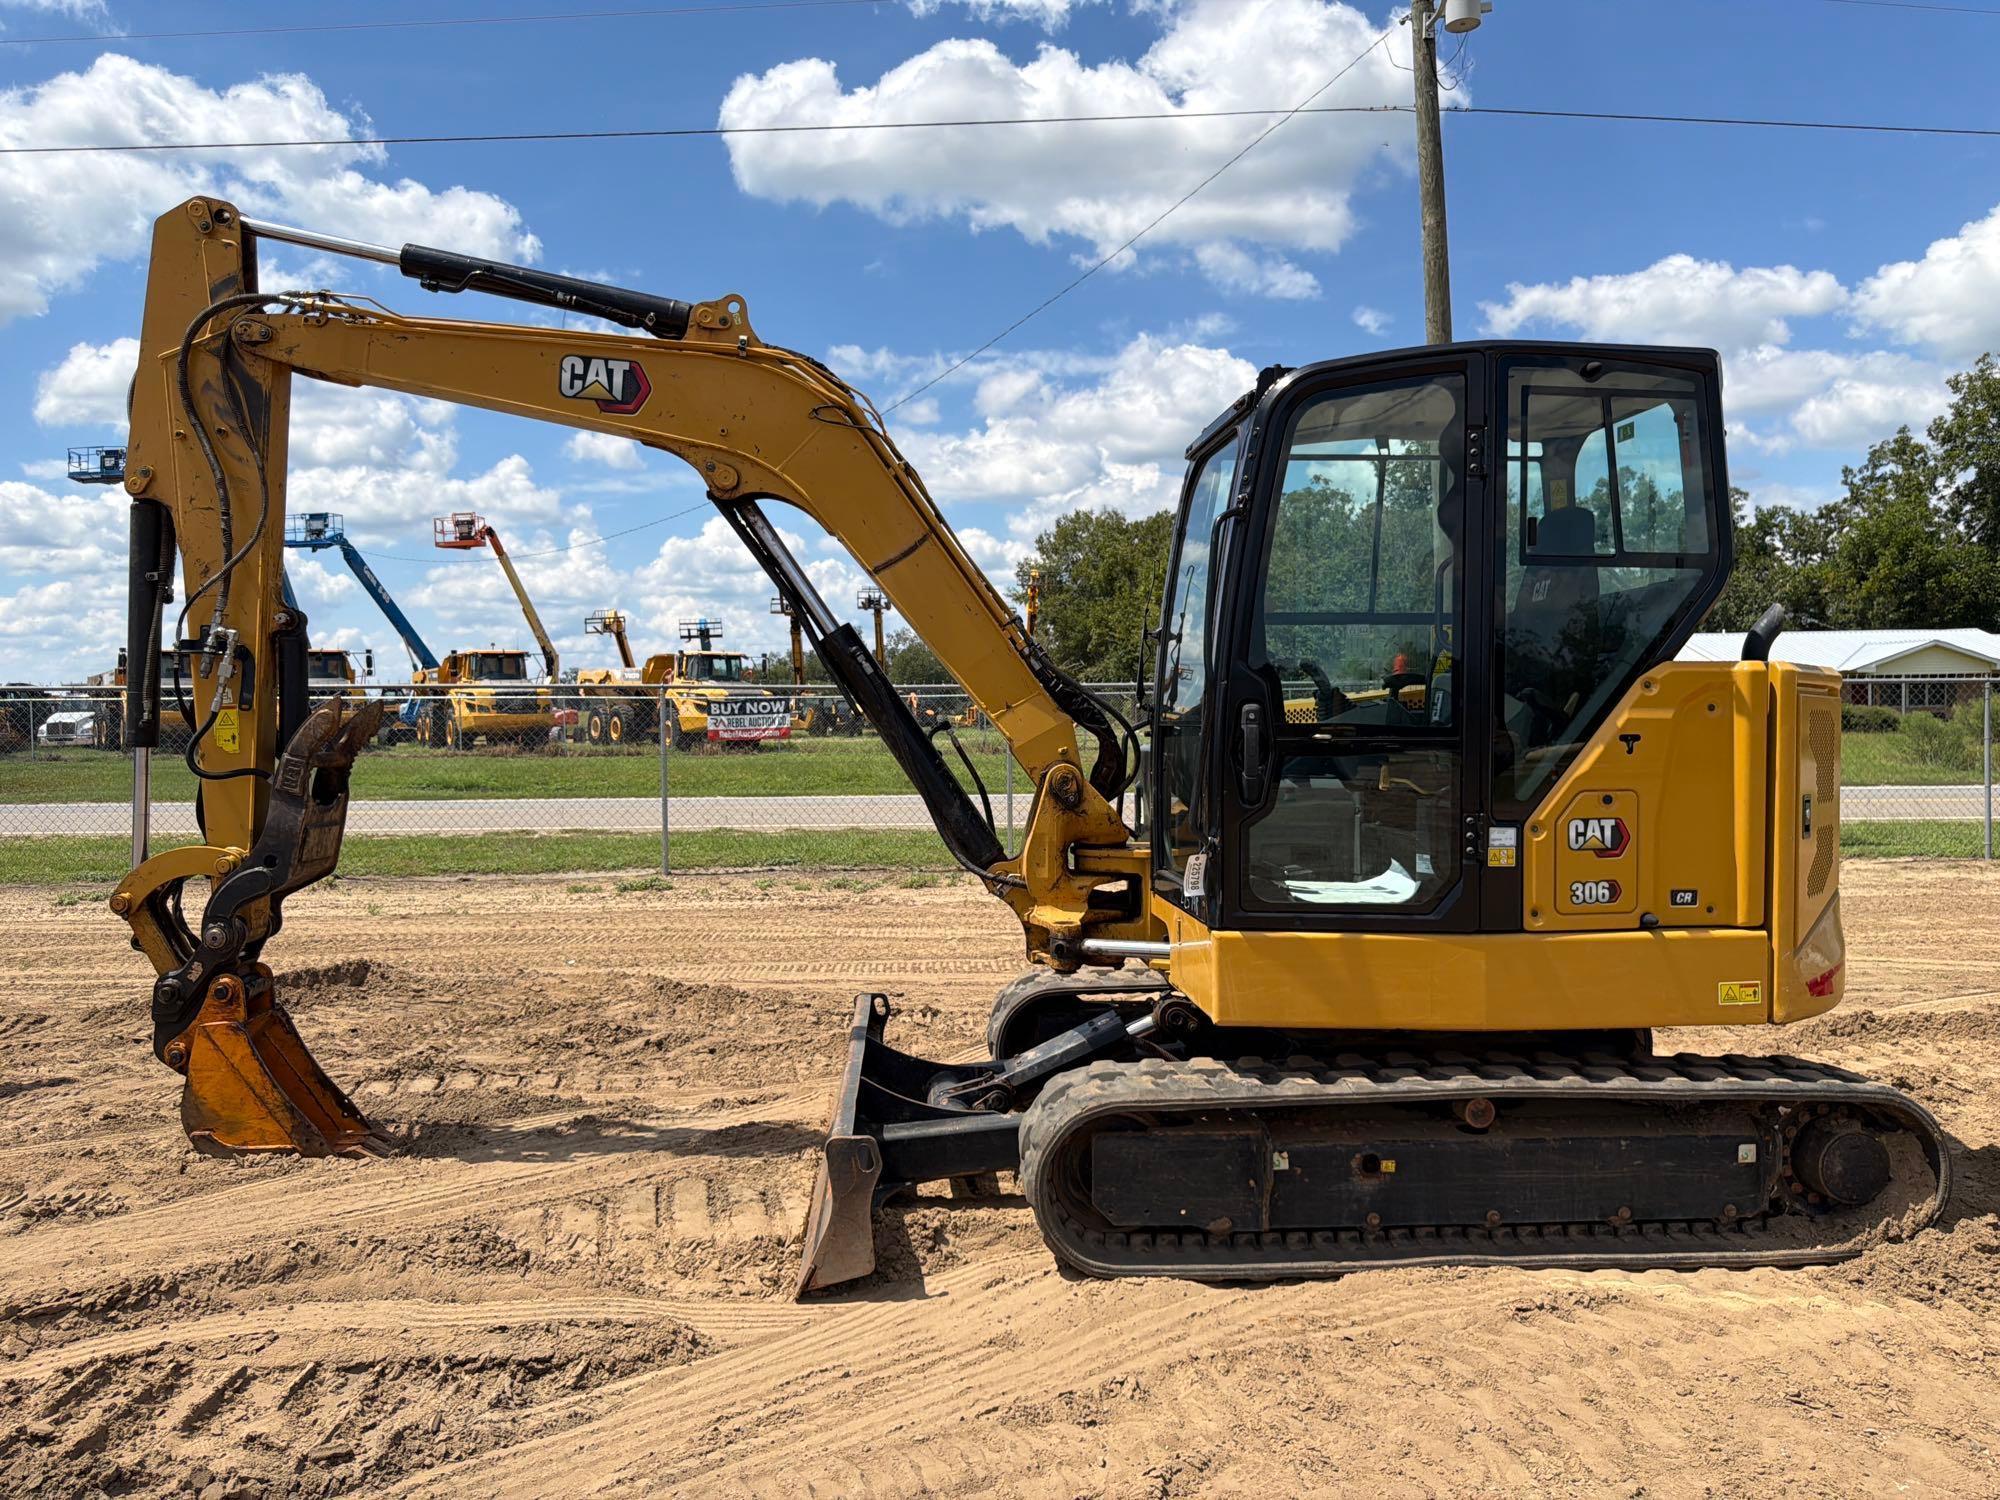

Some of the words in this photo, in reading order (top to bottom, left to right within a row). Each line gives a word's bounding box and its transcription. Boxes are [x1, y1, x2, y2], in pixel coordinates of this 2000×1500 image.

[561, 355, 630, 401] CAT
[710, 702, 741, 715] BUY
[746, 701, 786, 714] NOW
[728, 717, 747, 728] REBEL
[748, 716, 776, 728] AUCTION
[1568, 818, 1616, 850] CAT
[1190, 862, 1202, 891] 225798
[1570, 880, 1611, 904] 306
[1675, 892, 1694, 904] CR
